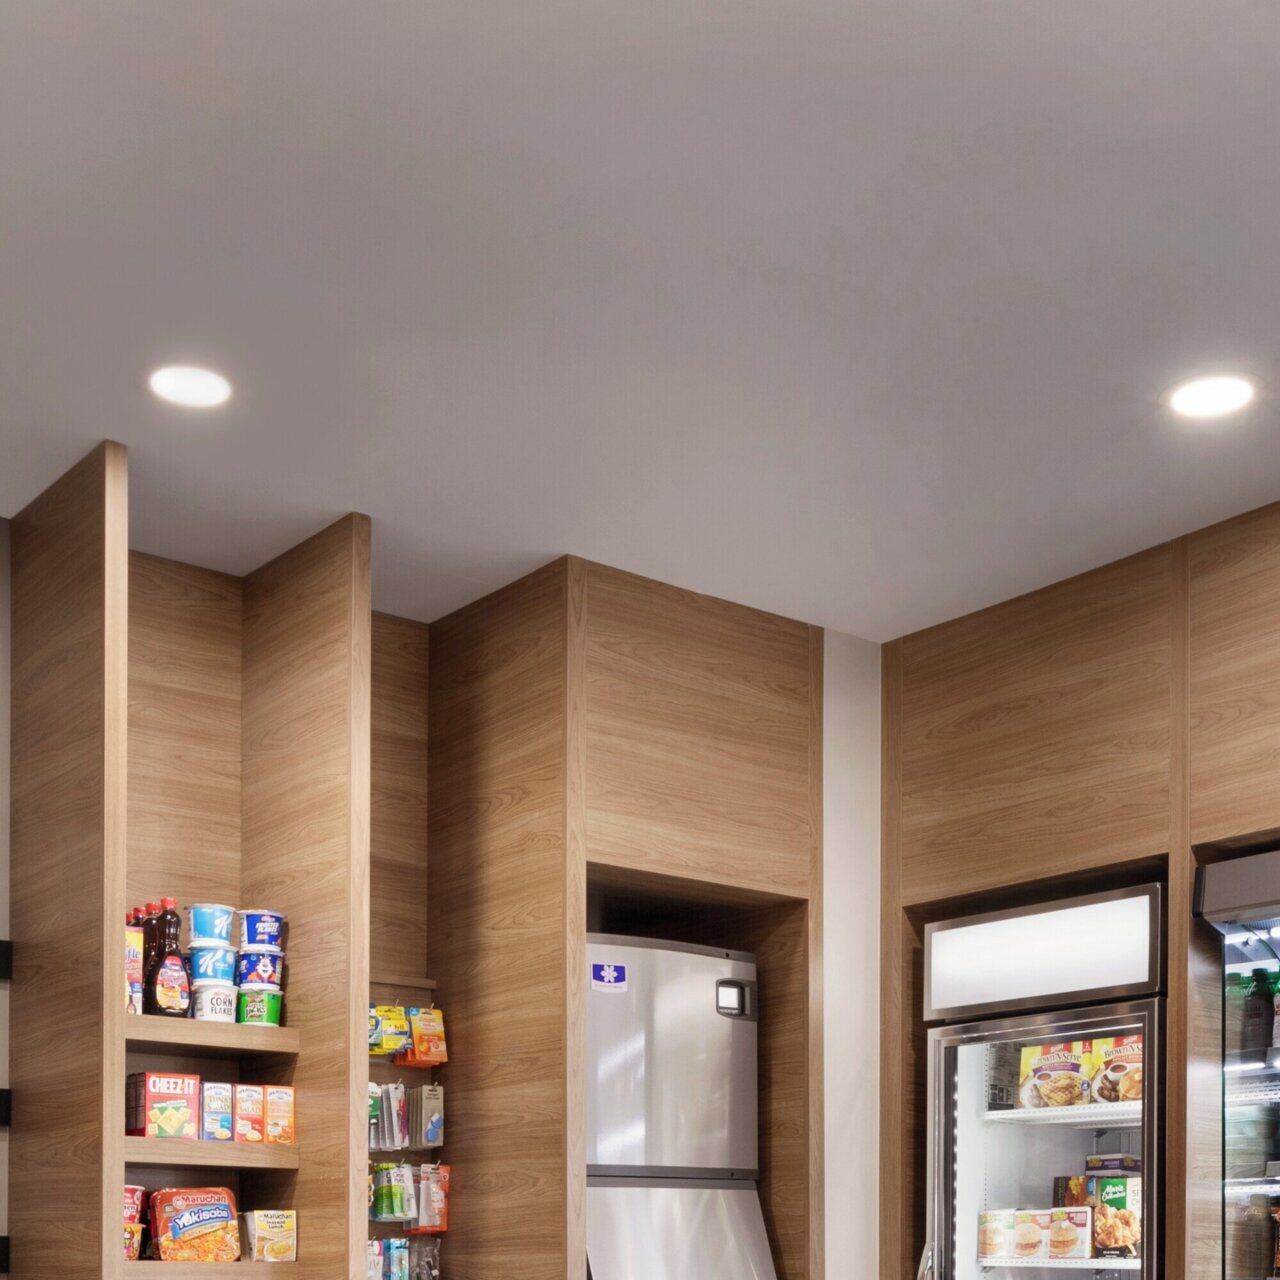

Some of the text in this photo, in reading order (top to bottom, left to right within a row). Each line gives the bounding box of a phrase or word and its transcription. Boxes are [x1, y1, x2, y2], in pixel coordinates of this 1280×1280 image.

[210, 997, 233, 1007] CORN
[210, 1006, 233, 1016] FLAKES
[148, 1077, 196, 1095] CHEEZ-IT
[182, 1195, 227, 1204] Maruchan
